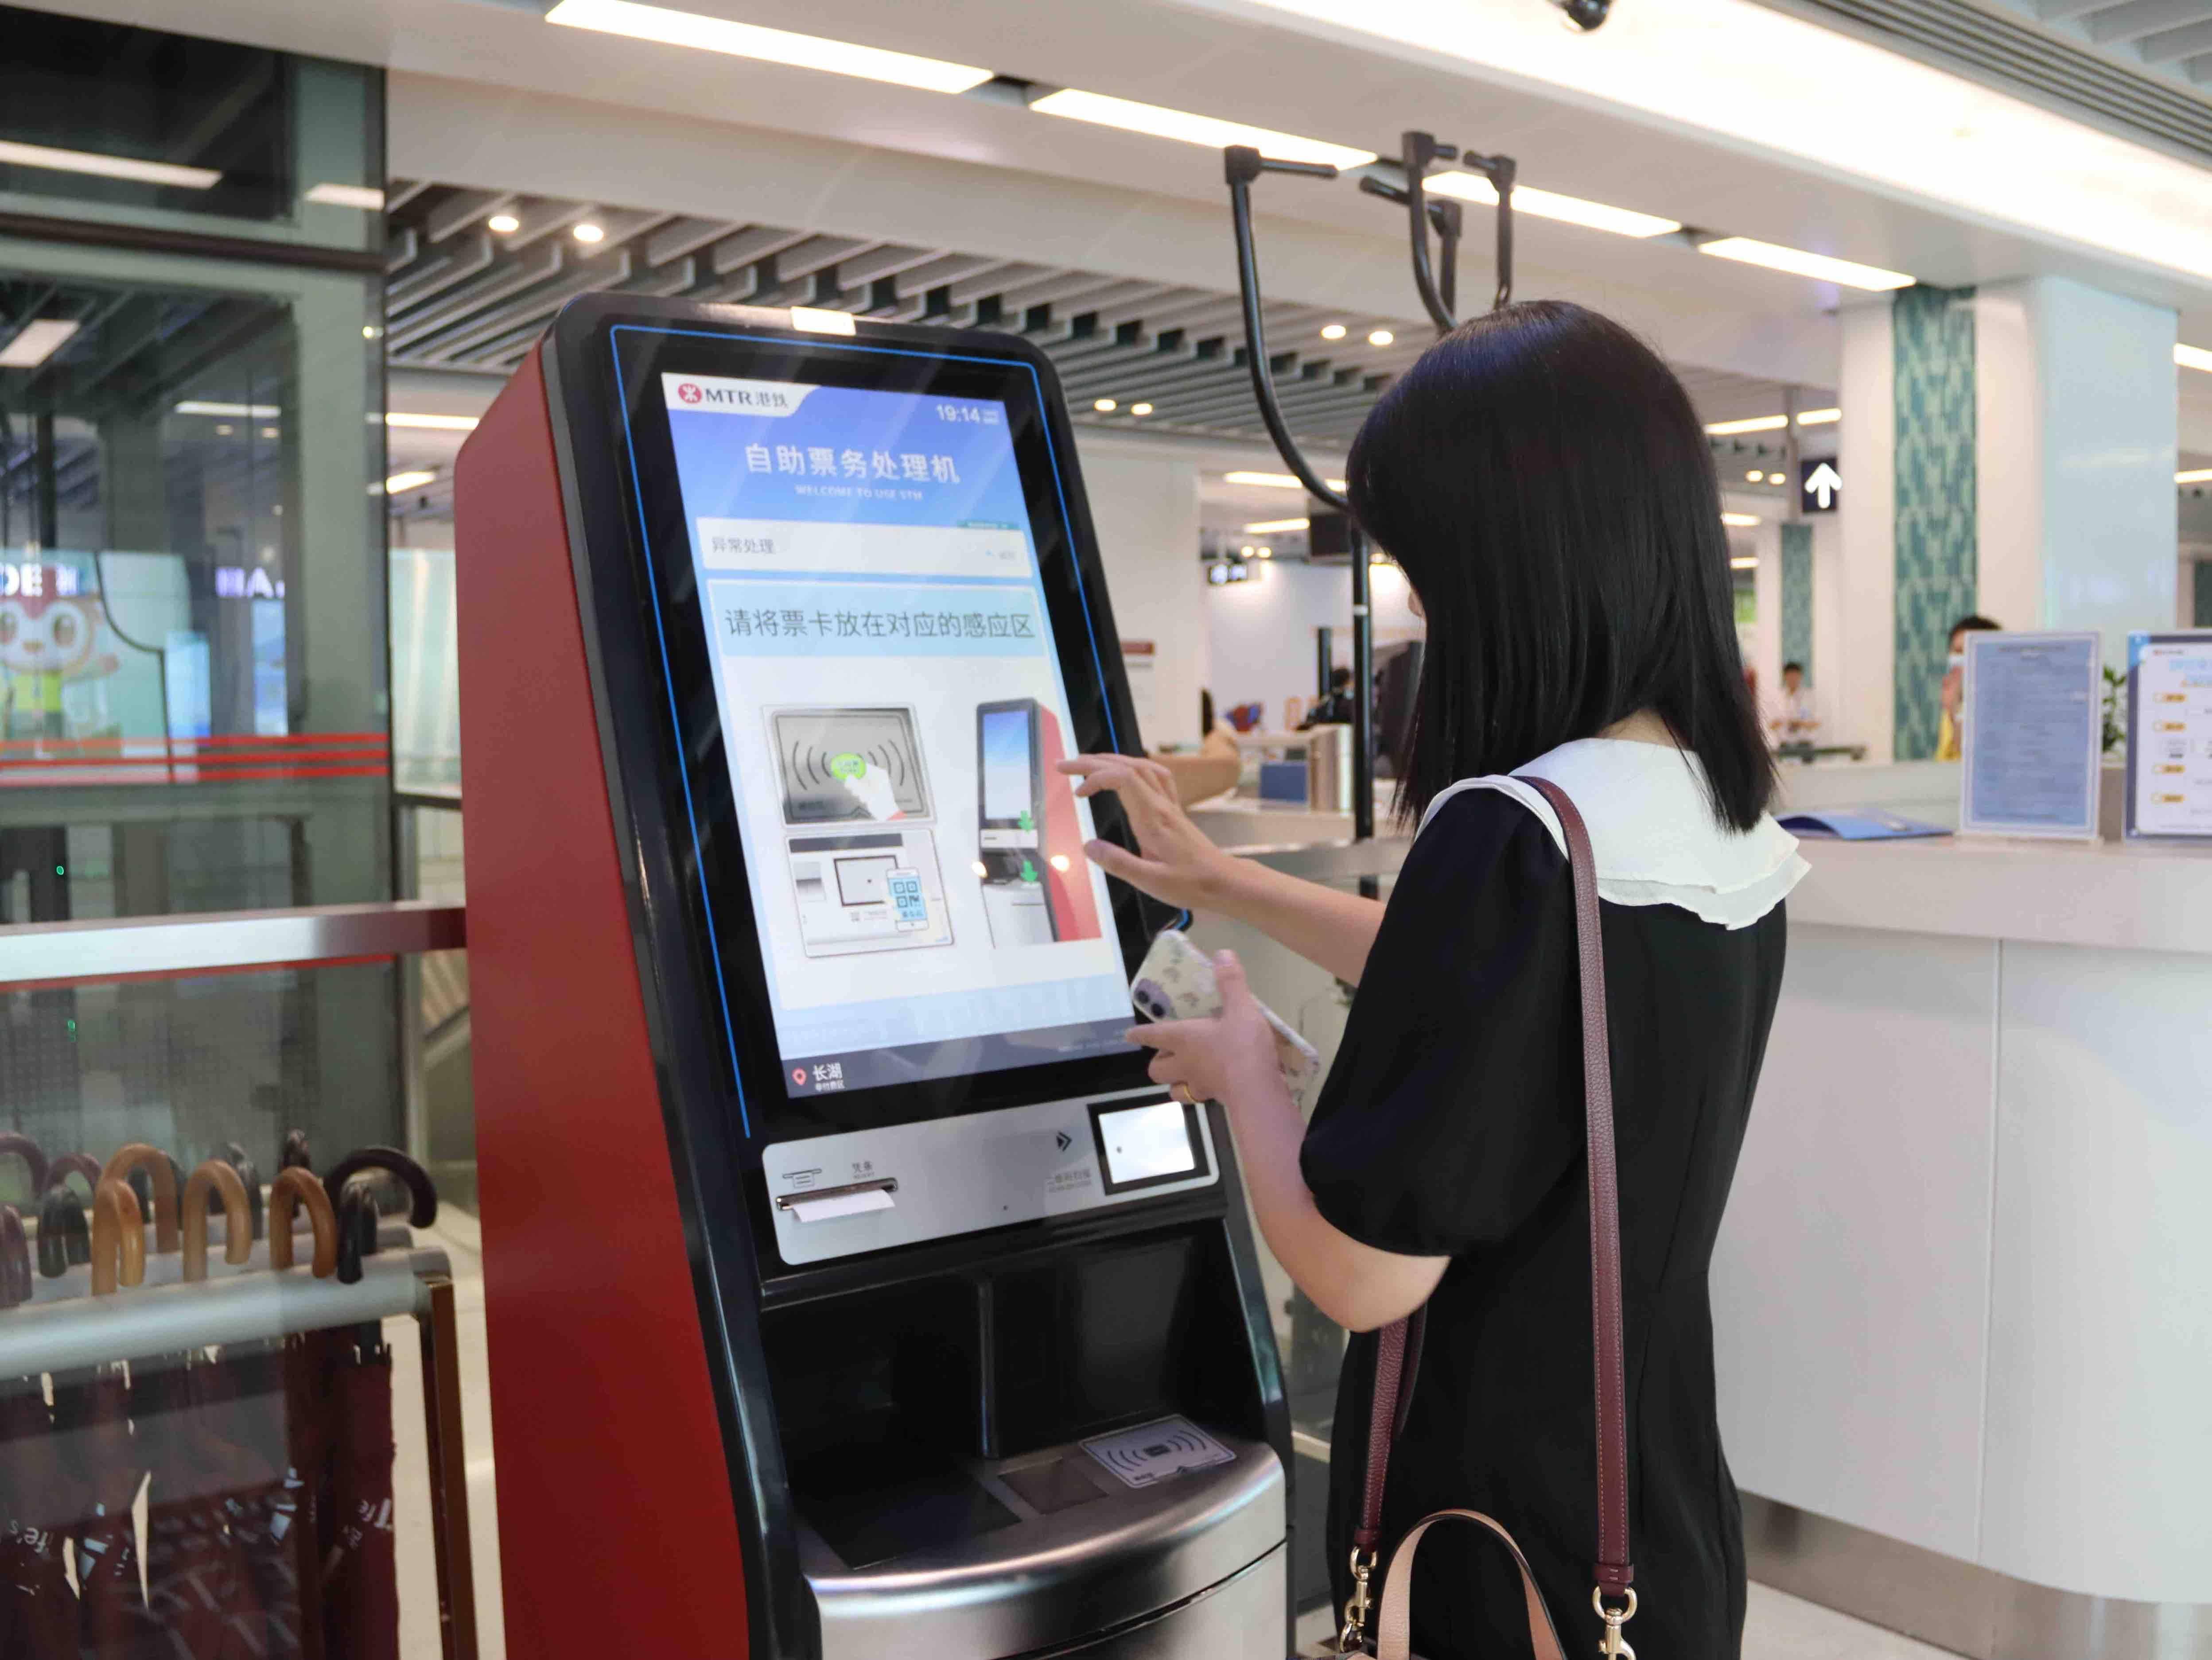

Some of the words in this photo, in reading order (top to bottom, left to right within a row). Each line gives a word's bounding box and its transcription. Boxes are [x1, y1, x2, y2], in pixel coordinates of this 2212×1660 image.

[705, 388, 752, 405] MTR
[755, 391, 789, 408] 港铁
[936, 403, 980, 423] 19:14
[745, 442, 960, 484] 自助票务处理机
[712, 536, 775, 555] 异常处理
[725, 609, 1036, 639] 请将票卡放在对应的感应区
[812, 1062, 844, 1081] 长湖
